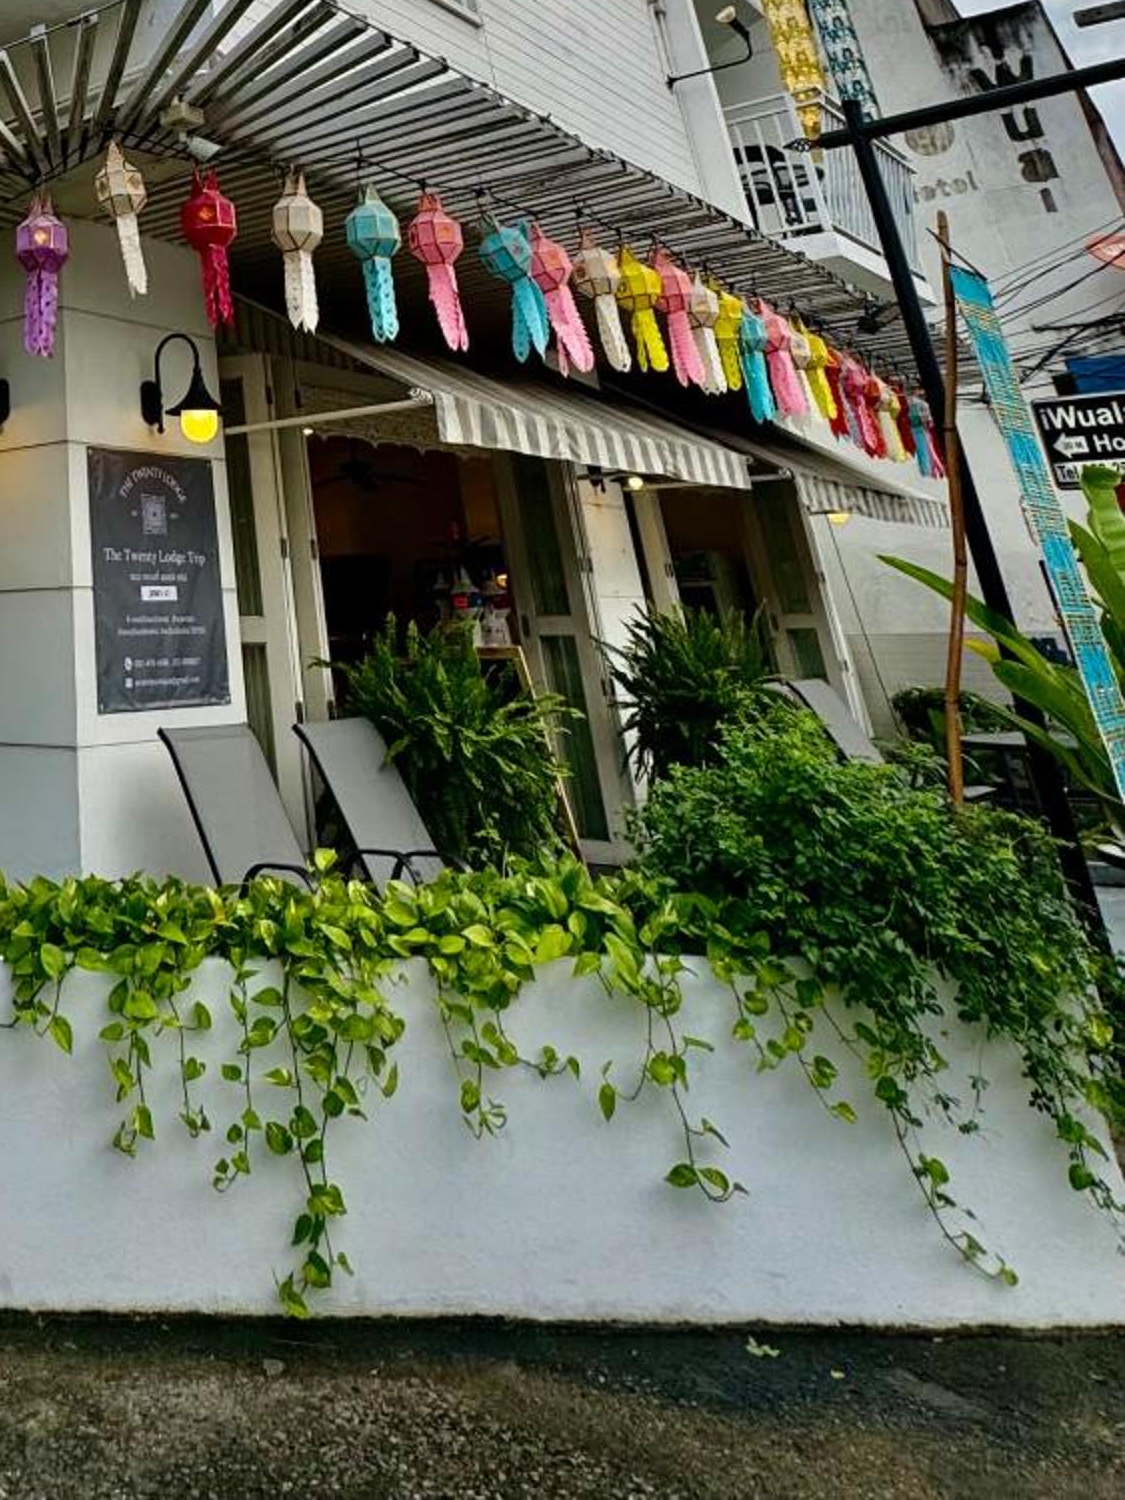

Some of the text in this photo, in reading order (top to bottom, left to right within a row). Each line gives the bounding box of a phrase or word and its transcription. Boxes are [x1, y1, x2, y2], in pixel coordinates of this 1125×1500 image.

[1038, 401, 1125, 431] iWual
[103, 547, 122, 561] The
[123, 548, 157, 566] Twenty
[158, 549, 186, 567] Lodge
